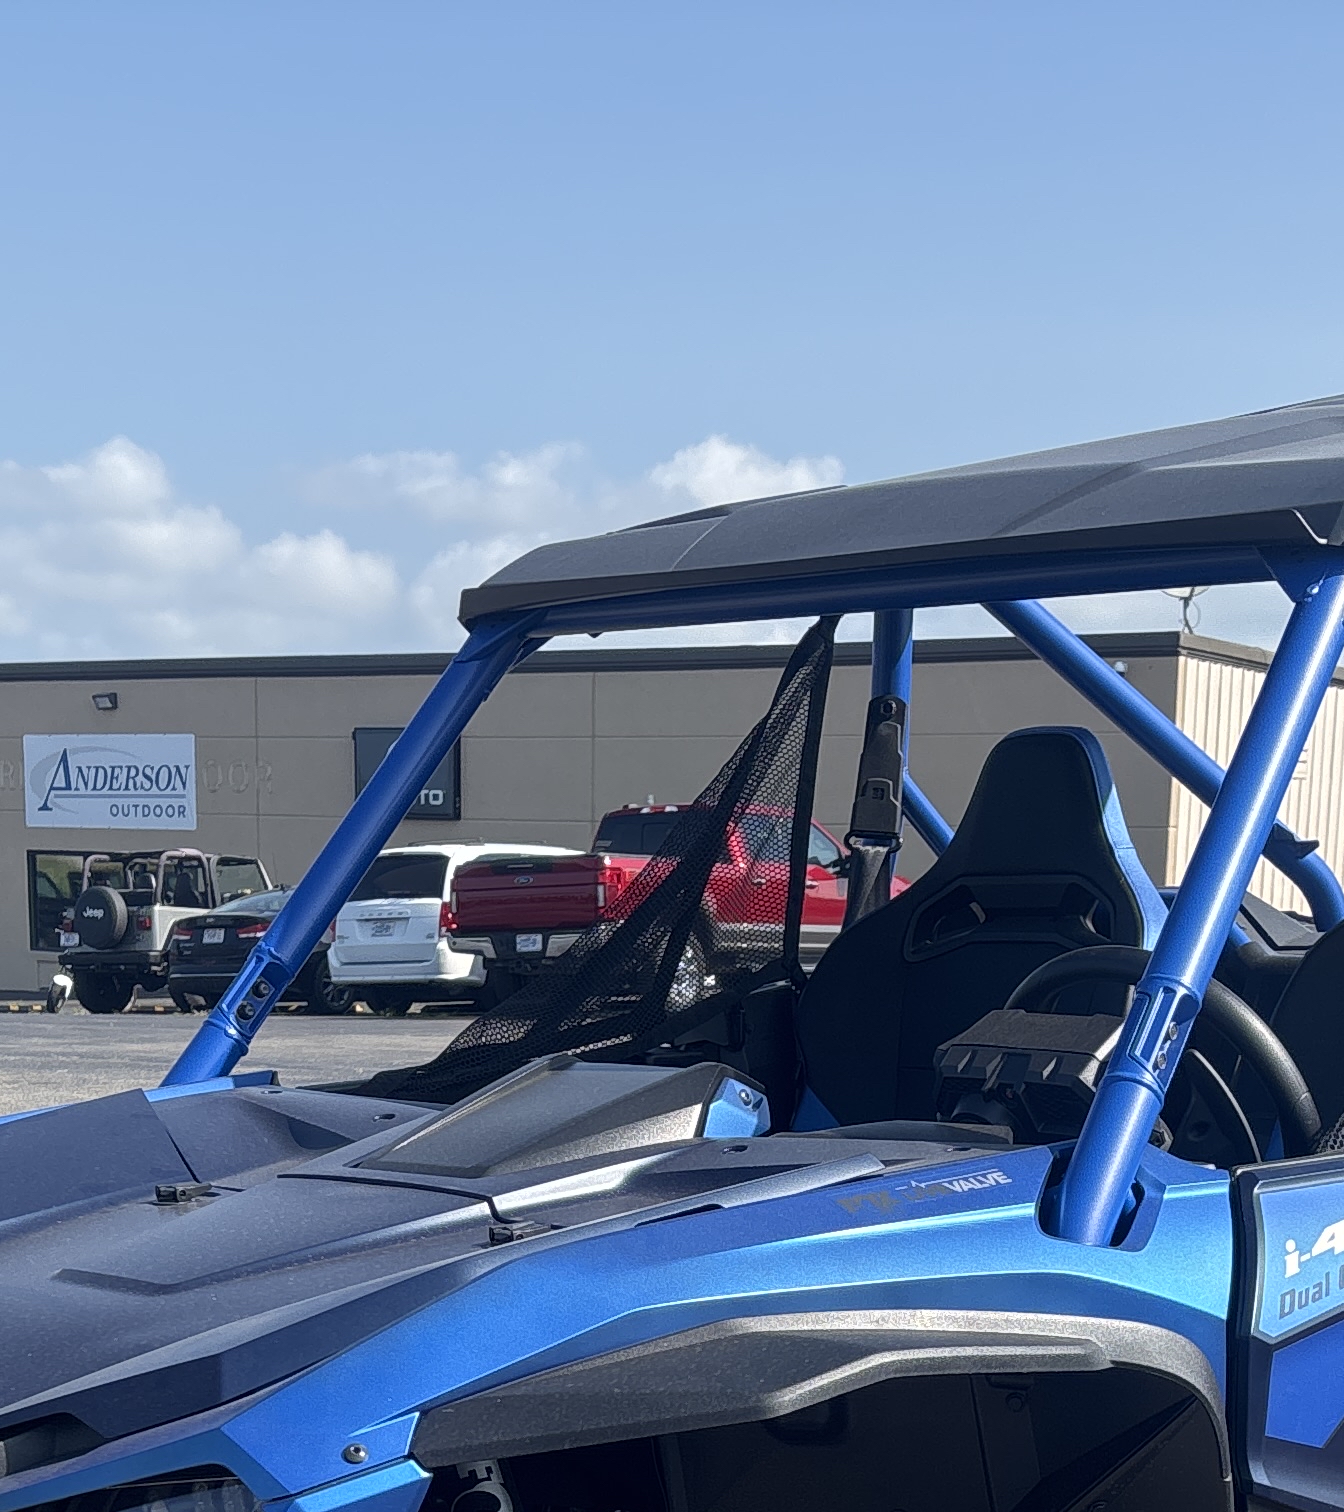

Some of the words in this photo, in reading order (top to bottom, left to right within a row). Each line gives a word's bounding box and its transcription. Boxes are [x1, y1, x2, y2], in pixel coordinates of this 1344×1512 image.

[38, 748, 191, 812] ANDERSON
[109, 803, 187, 819] OUTDOOR
[1278, 1276, 1331, 1320] Dual
